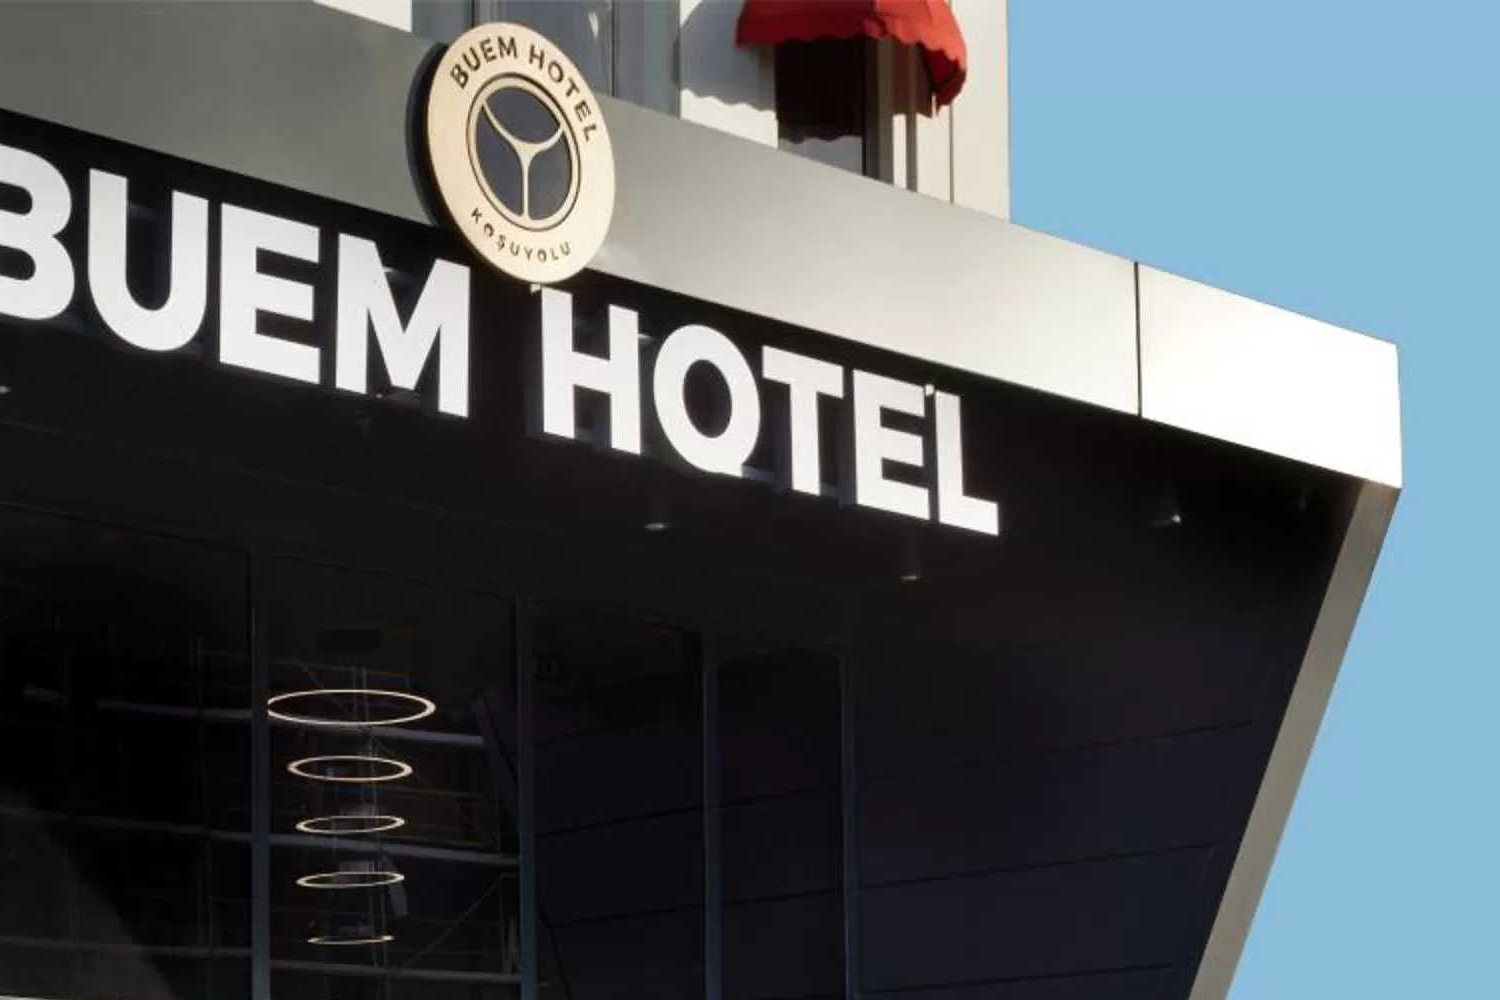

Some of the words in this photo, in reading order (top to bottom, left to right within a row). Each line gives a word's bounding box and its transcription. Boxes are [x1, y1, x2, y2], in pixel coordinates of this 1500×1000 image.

[450, 35, 519, 90] BUEM
[529, 43, 598, 142] HOTEL
[541, 287, 998, 535] HOTEL
